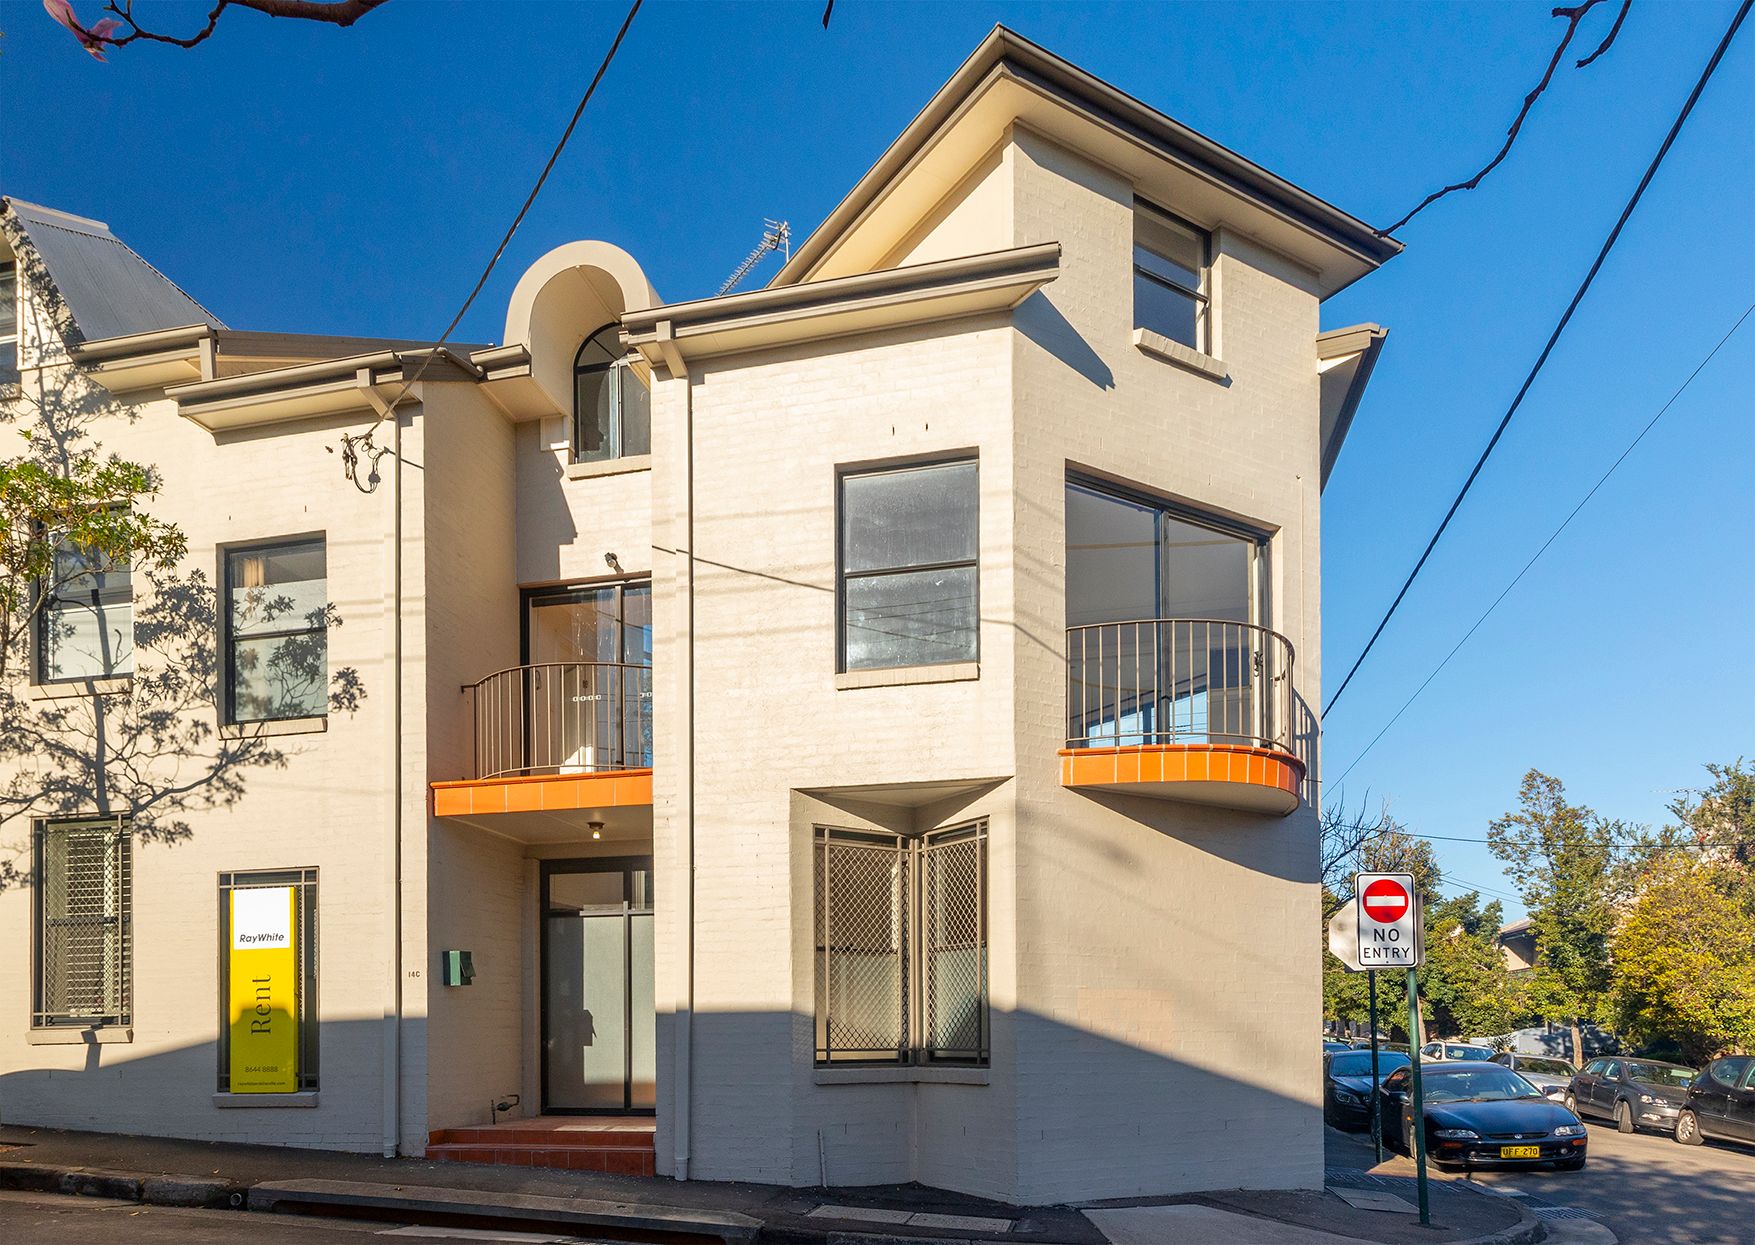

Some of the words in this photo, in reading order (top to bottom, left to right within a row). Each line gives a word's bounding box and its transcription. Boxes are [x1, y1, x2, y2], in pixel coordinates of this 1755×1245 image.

[1374, 928, 1400, 942] NO
[1363, 947, 1410, 959] ENTRY
[251, 974, 271, 1035] Rent
